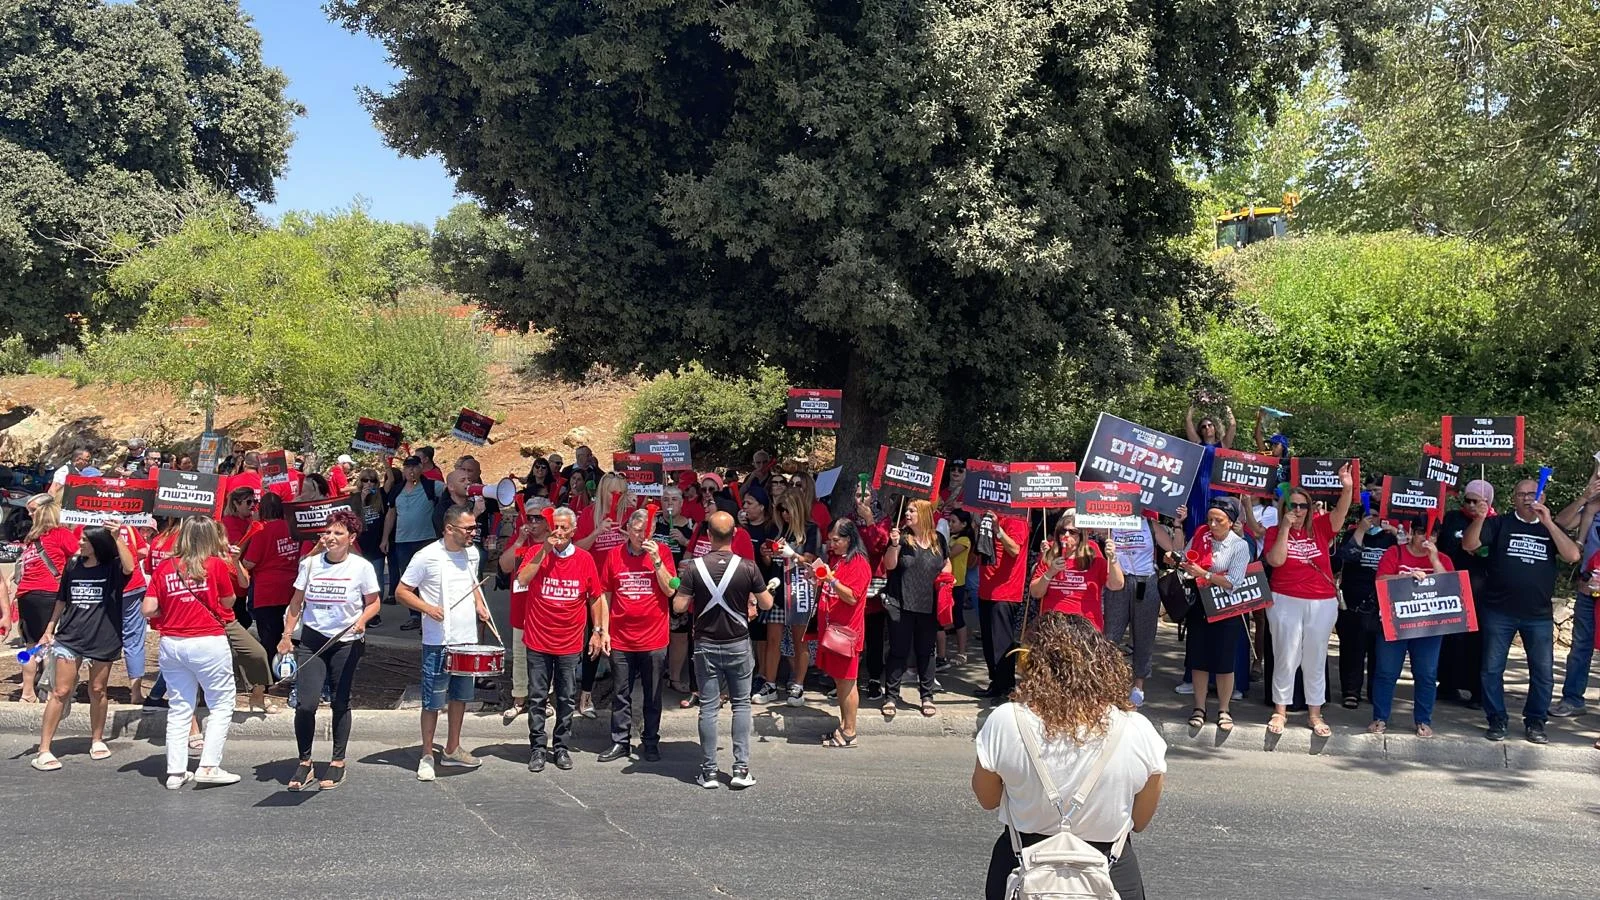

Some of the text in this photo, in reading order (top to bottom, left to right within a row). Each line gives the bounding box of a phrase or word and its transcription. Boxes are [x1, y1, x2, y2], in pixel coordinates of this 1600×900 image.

[1458, 437, 1510, 445] מתייבשת
[1110, 438, 1184, 474] נאבקים
[1223, 460, 1269, 474] שכר הוגן
[1429, 458, 1460, 473] שכר הוגן
[888, 468, 930, 482] מתייבשת
[1091, 456, 1185, 496] על הזכויות
[1222, 470, 1267, 488] עכשיו!
[1427, 468, 1457, 486] עכשיו!
[177, 482, 198, 490] ישראל
[980, 479, 996, 489] הוגן
[162, 490, 211, 501] מתייבשת
[1394, 496, 1435, 506] מתייבשת
[79, 499, 140, 509] מתייבשת
[1088, 502, 1130, 511] מתייבשת
[1512, 541, 1544, 551] מתייבשת
[1214, 587, 1262, 609] עכשיו!
[1400, 599, 1457, 615] מתייבשת
